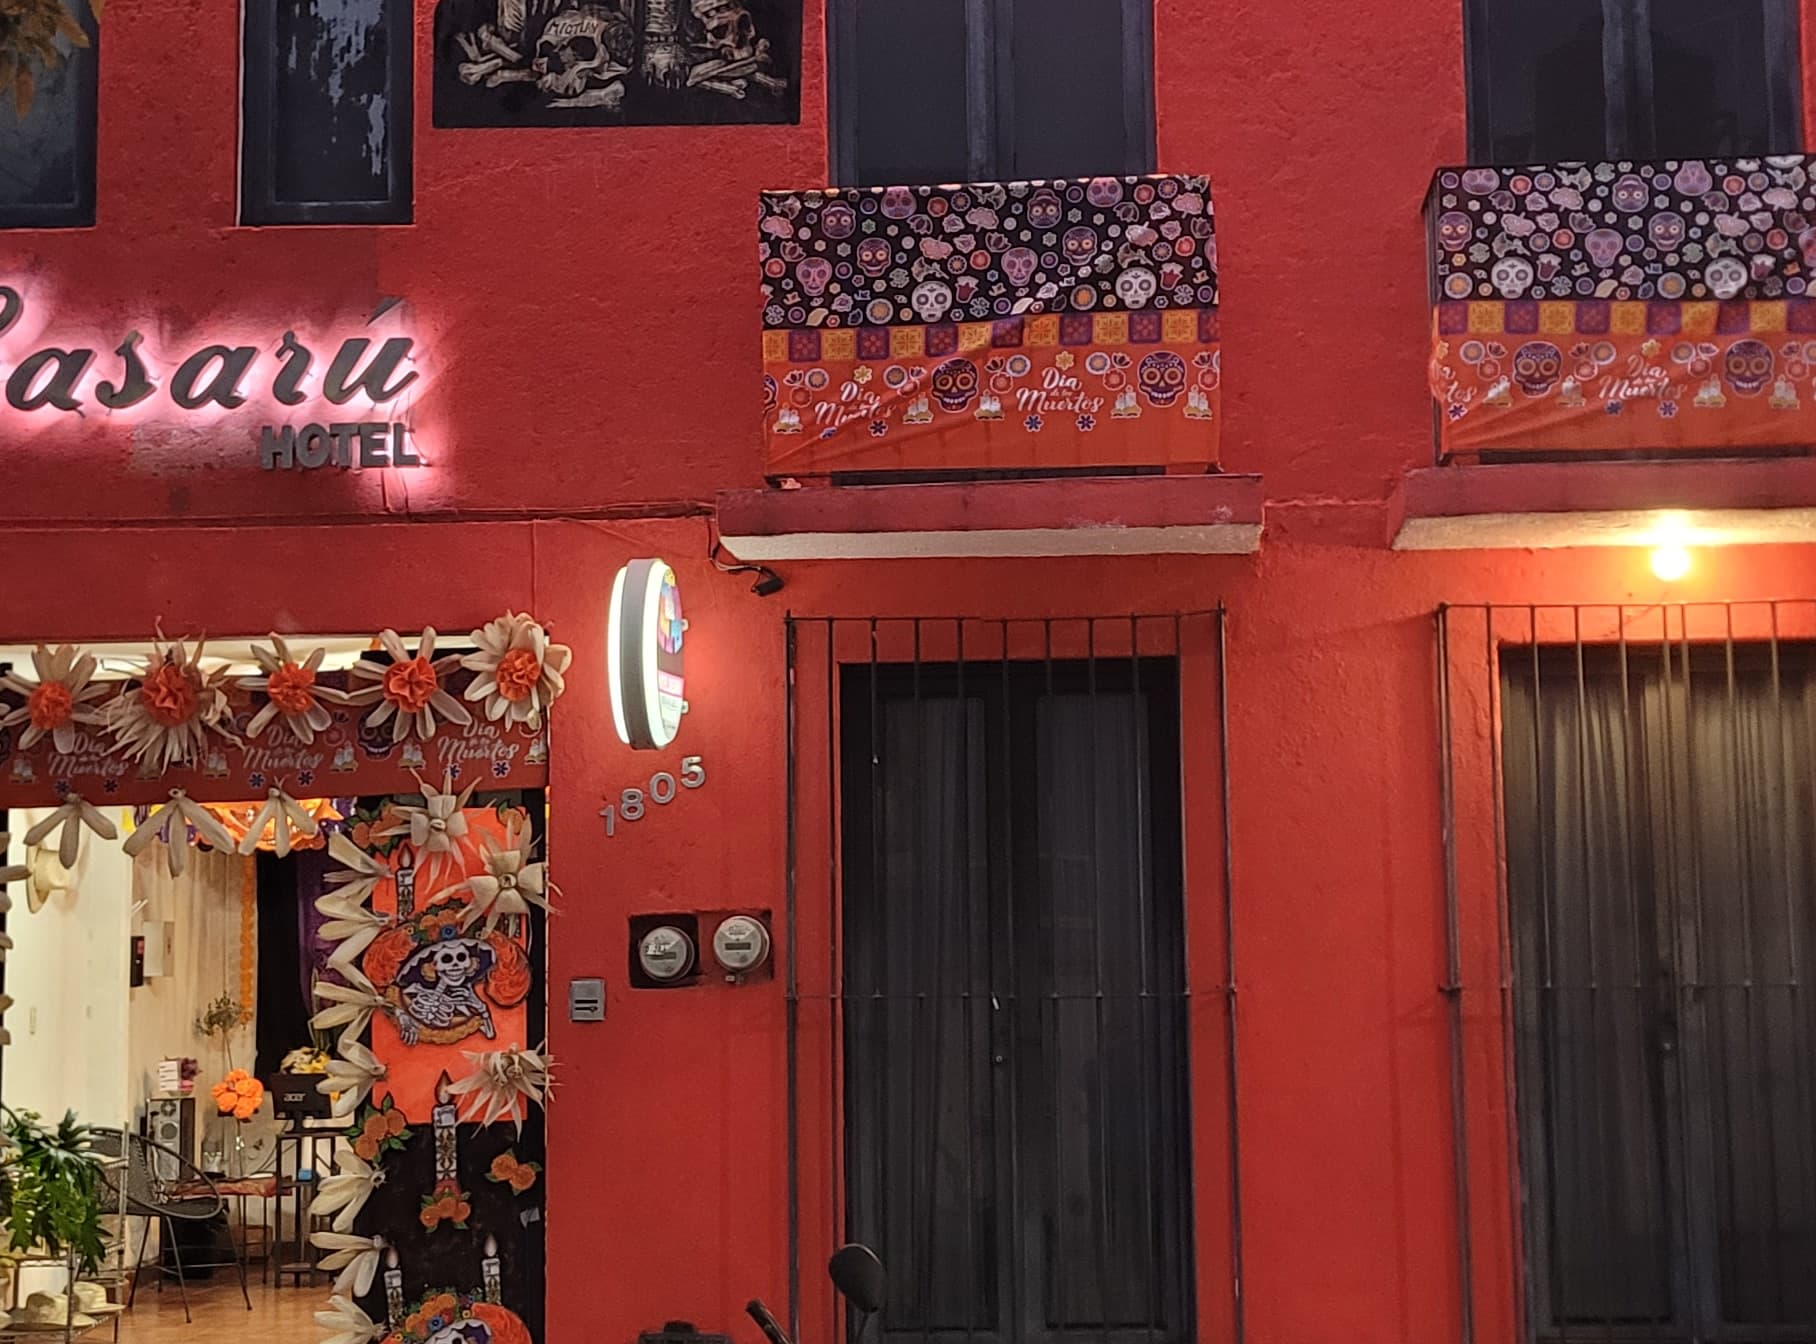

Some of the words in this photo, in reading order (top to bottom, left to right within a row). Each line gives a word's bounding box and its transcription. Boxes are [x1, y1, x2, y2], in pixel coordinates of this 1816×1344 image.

[1016, 387, 1104, 414] Muertos
[1599, 375, 1688, 400] Muertos
[261, 421, 420, 471] HOTEL
[243, 746, 324, 772] Muertos
[438, 736, 520, 763] Muertos
[48, 753, 129, 778] Muertos
[598, 755, 706, 837] 1805
